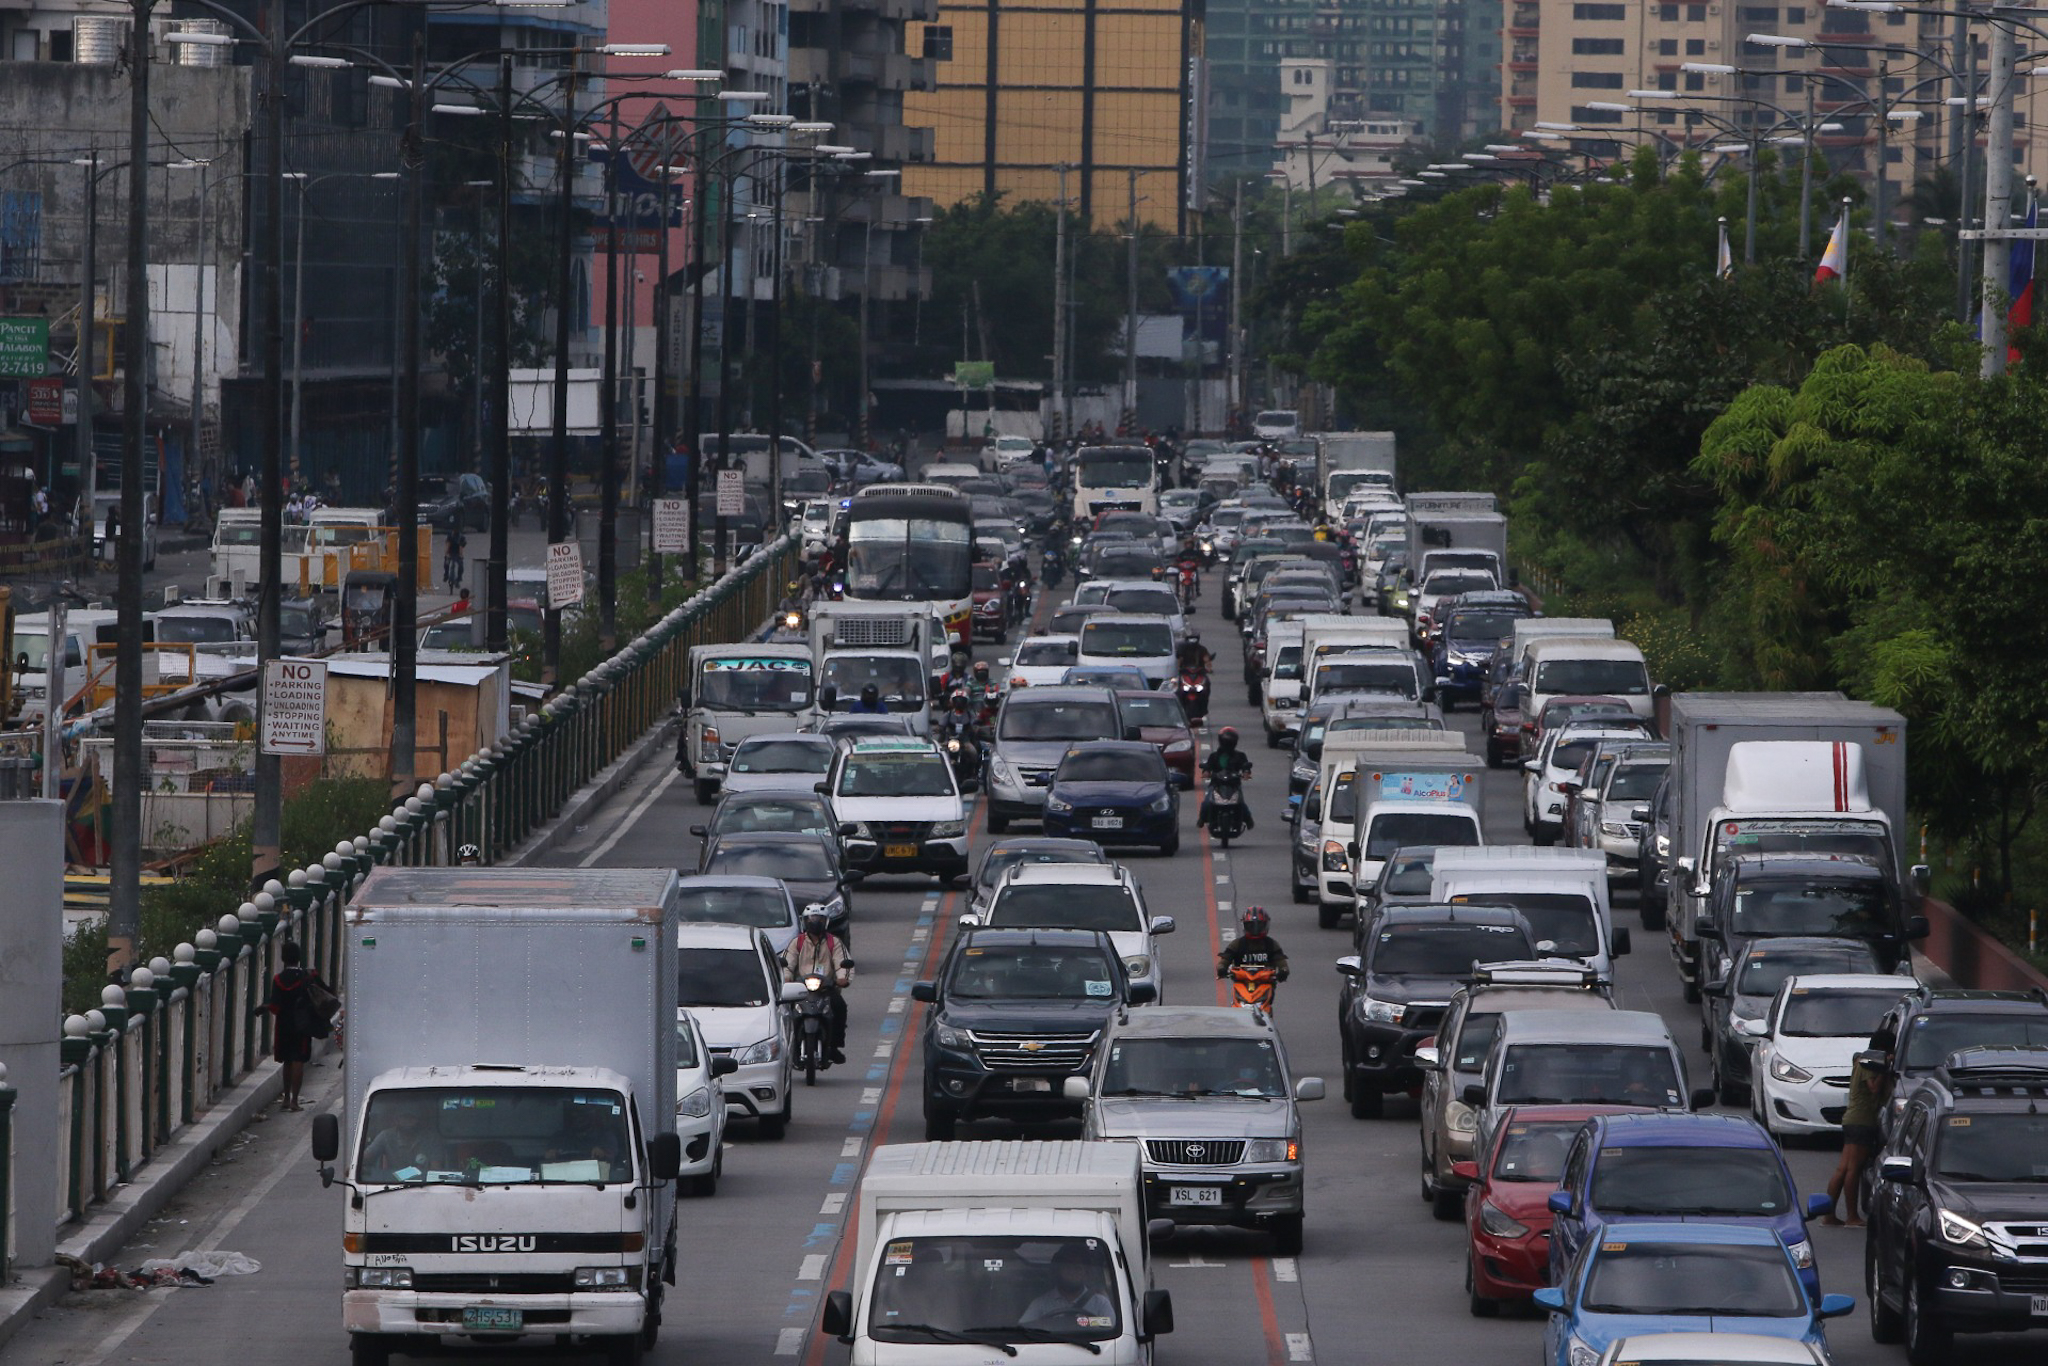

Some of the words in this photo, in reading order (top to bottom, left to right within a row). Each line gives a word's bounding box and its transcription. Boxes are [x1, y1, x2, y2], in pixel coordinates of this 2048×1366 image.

[723, 472, 737, 480] NO
[663, 501, 680, 510] NO
[553, 545, 571, 557] NO
[726, 661, 788, 671] JAC
[282, 665, 311, 680] NO
[274, 681, 321, 690] PARKING
[274, 691, 321, 700] LOADING
[273, 701, 320, 711] UNLOADING
[272, 711, 320, 721] STOPPING
[272, 721, 320, 731] WAITING
[271, 731, 315, 739] ANYTIME
[1413, 789, 1446, 797] AlcoPlus
[1476, 925, 1515, 934] TRD
[1175, 1189, 1193, 1201] XSL
[1199, 1190, 1217, 1201] 621
[452, 1236, 537, 1252] ISUZU
